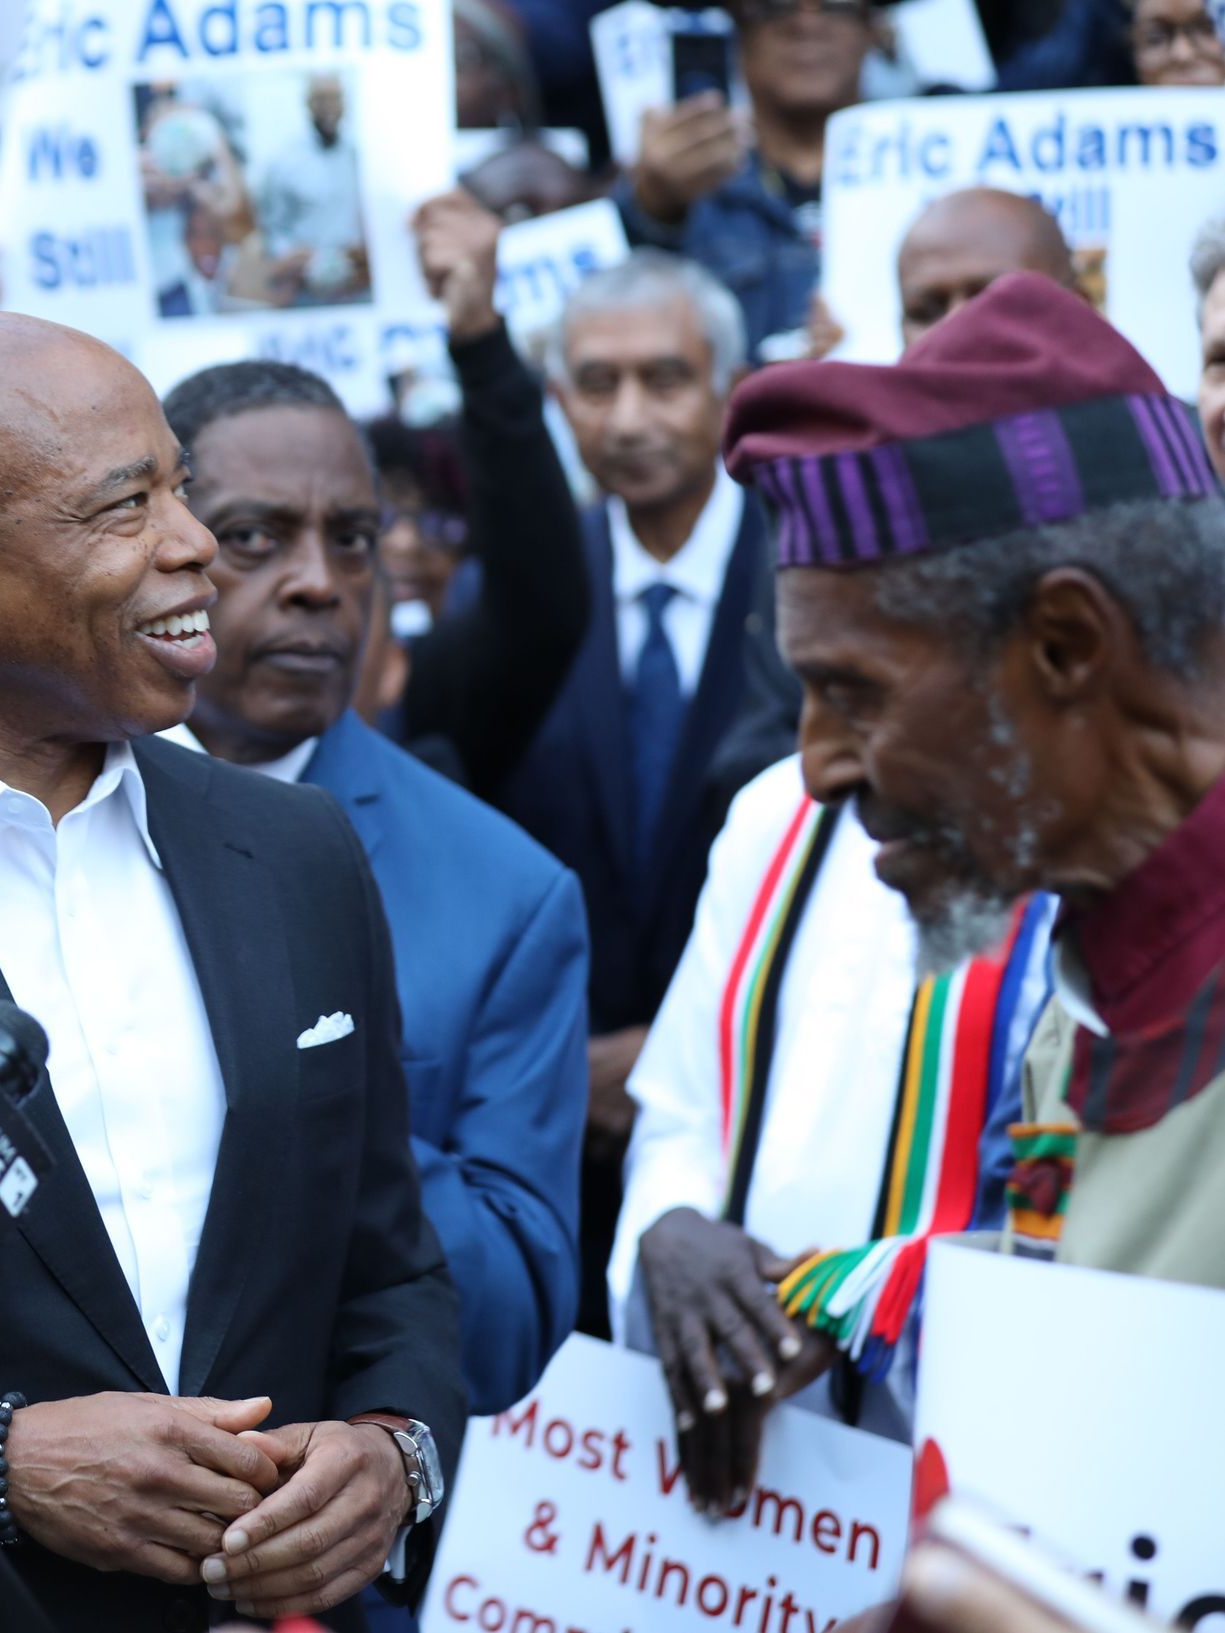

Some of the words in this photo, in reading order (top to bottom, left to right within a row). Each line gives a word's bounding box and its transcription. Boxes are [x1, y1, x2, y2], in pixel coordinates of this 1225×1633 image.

[134, 0, 426, 64] Adams
[976, 110, 1219, 173] Adams
[489, 1400, 632, 1481] Most
[523, 1500, 560, 1558] &
